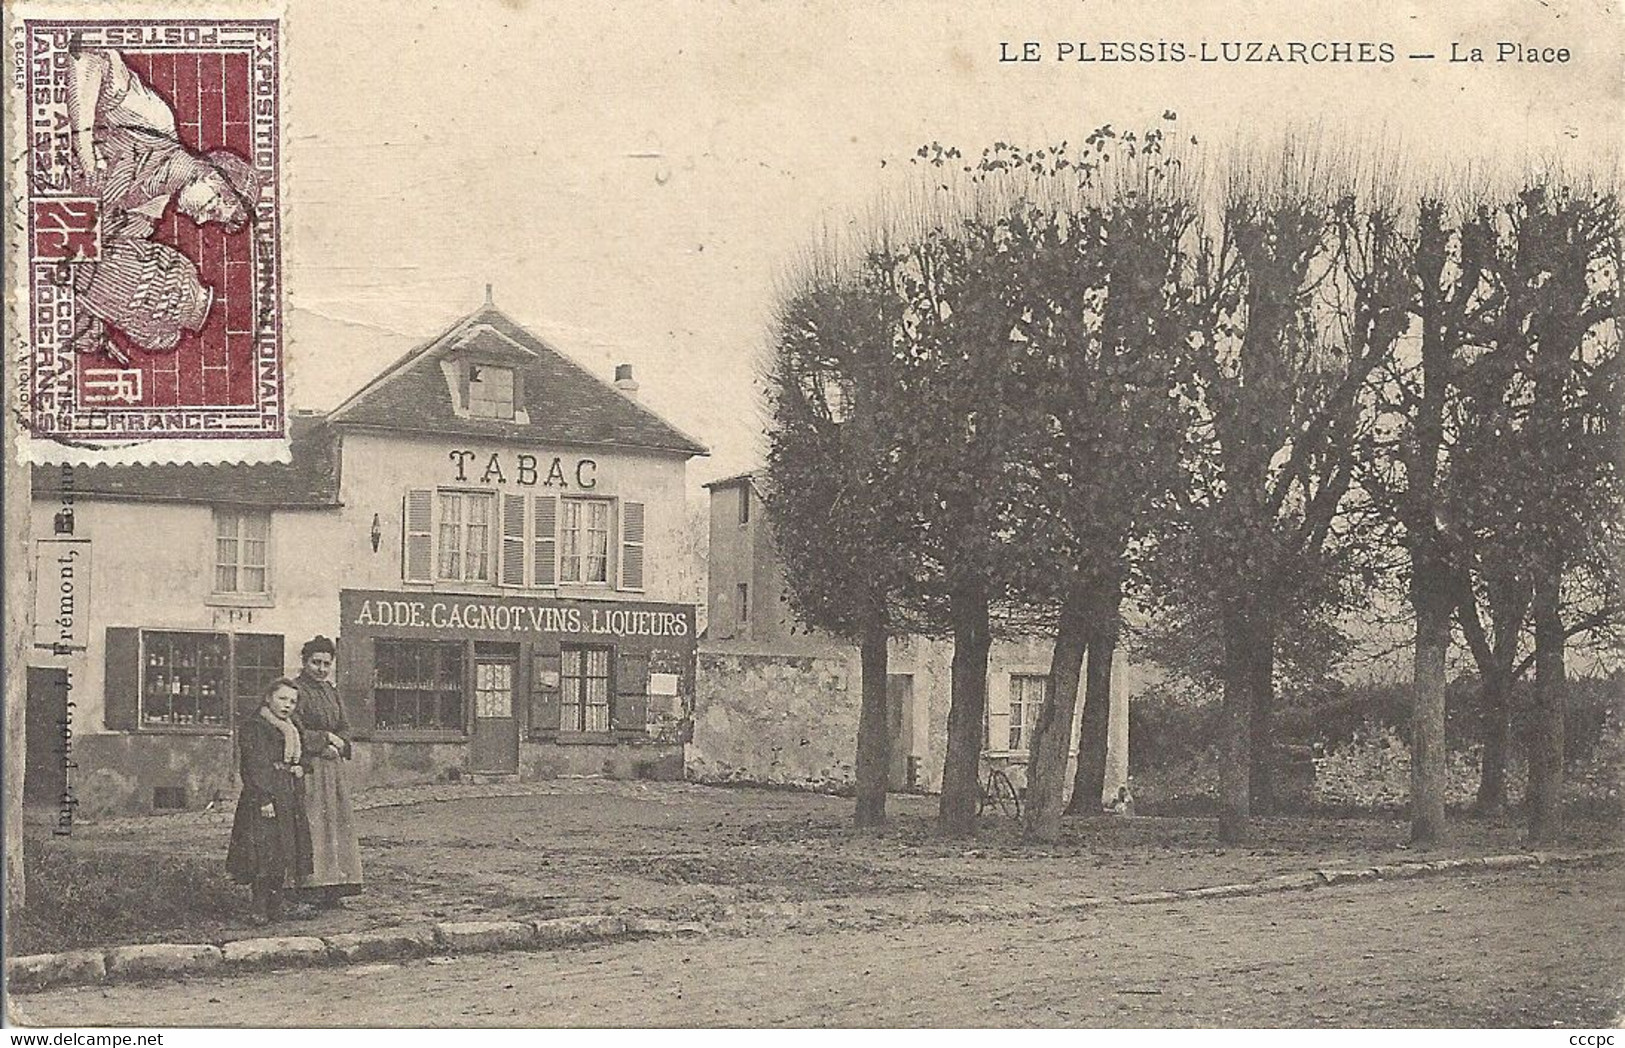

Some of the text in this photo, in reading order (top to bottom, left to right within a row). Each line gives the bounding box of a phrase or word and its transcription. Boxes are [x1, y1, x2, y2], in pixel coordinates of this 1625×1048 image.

[106, 28, 218, 45] POSTES
[998, 38, 1571, 64] LE PLESSIS-LUZARCHES La Place
[255, 27, 278, 430] EXPOSITION INTERNATIONALE
[37, 266, 56, 431] MODERNES
[110, 413, 223, 431] FRANCE
[450, 450, 598, 489] TABAC
[53, 548, 79, 656] Frémont,
[527, 606, 581, 633] VINS
[591, 608, 688, 637] LIQUEURS
